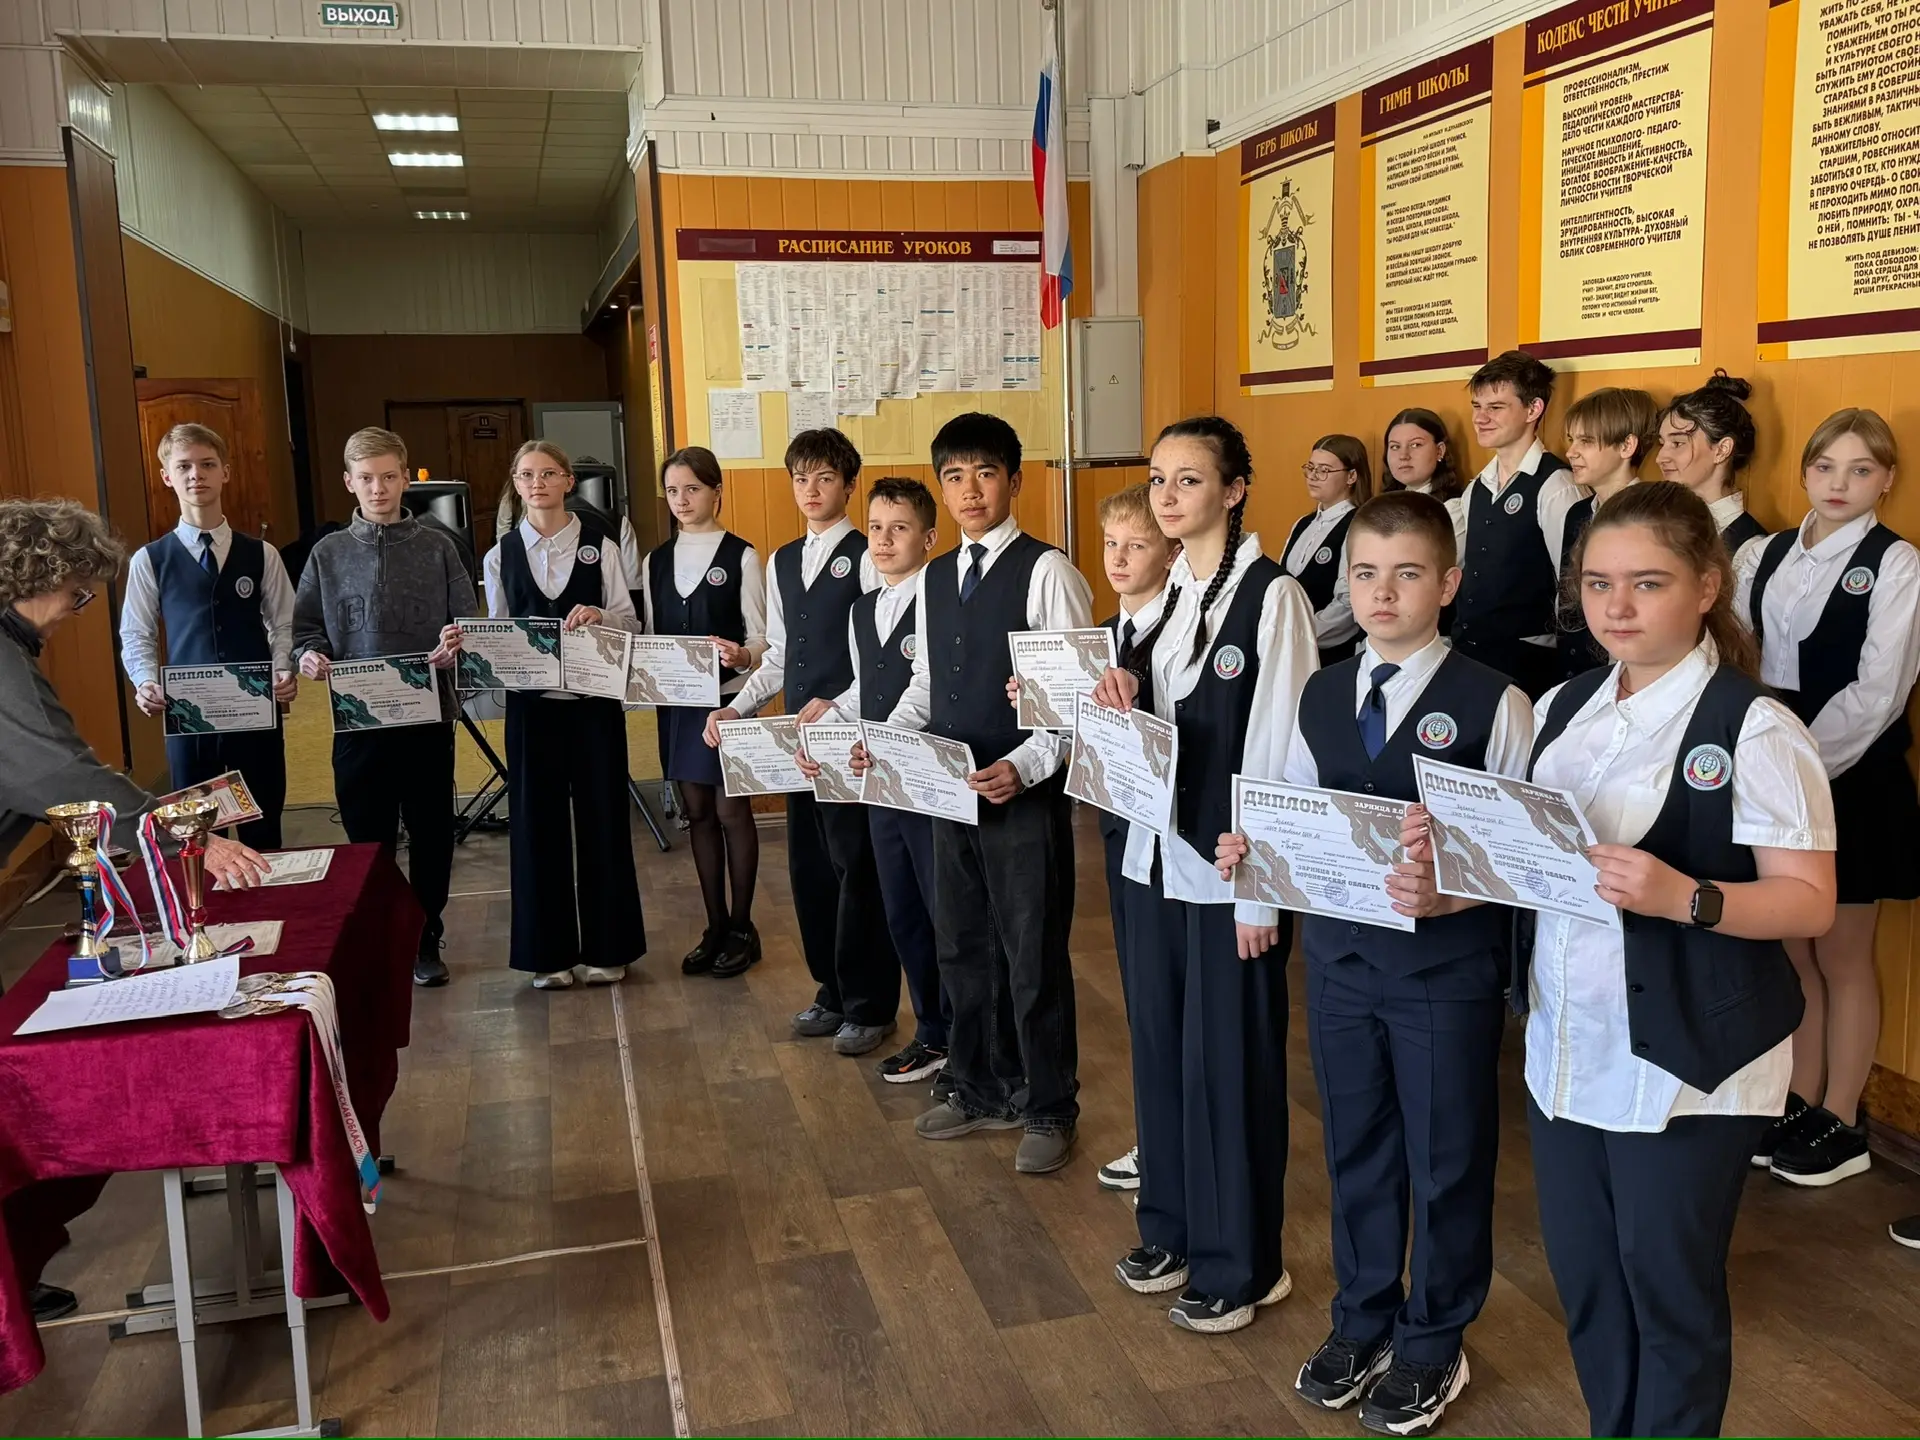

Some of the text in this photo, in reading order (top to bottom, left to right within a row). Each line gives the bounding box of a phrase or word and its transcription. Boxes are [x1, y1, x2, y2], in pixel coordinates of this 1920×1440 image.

[327, 8, 390, 24] ВЫХОД
[1818, 10, 1859, 31] УВАЖАТЬ
[1860, 2, 1884, 17] СЕБЯ,
[1820, 2, 1844, 17] ЖИТЬ
[1537, 16, 1585, 54] КОДЕКС
[1589, 1, 1629, 33] ЧЕСТИ
[1826, 20, 1872, 42] ПОМНИТЬ,
[1874, 12, 1892, 25] ЧТО
[1894, 6, 1907, 20] ТЫ
[1825, 33, 1913, 67] И КУЛЬТУРЕ СВОЕГО
[1826, 44, 1831, 54] С
[1833, 26, 1888, 52] УВАЖЕНИЕМ
[1815, 44, 1920, 82] БЫТЬ ПАТРИОТОМ СВОЕ
[1379, 63, 1469, 114] ГИМН ШКОЛЫ
[1563, 61, 1642, 94] ПРОФЕССИОНАЛИЗМ,
[1563, 62, 1669, 103] ОТВЕТСТВЕННОСТЬ, ПРЕСТИЖ
[1814, 75, 1855, 94] СЛУЖИТЬ
[1856, 68, 1875, 82] ЕМУ
[1823, 83, 1868, 104] СТАРАТЬСЯ
[1870, 81, 1876, 92] В
[1562, 92, 1633, 121] ВЫСОКИЙ УРОВЕНЬ
[1562, 103, 1630, 131] ПЕДАГОГИЧЕСКОГО
[1812, 96, 1920, 133] БЫТЬ ВЕЖЛИВЫМ, ТАКТИЧ
[1822, 97, 1867, 117] ЗНАНИЯМИ
[1868, 95, 1874, 105] В
[1561, 99, 1681, 142] ДЕЛО ЧЕСТИ КАЖДОГО УЧИТЕЛЯ
[1256, 120, 1318, 159] ГЕРБ ШКОЛЫ
[1811, 121, 1881, 147] ДАННОМУ СЛОВУ.
[1819, 125, 1920, 156] УВАЖИТЕЛЬНО ОТНОСИТ
[1561, 141, 1594, 157] НАУЧНОЕ
[1561, 139, 1643, 167] ГИЧЕСКОЕ МЫШЛЕНИЕ,
[1561, 139, 1687, 177] ИНИЦИАТИВНОСТЬ И АКТИВНОСТЬ,
[1862, 139, 1920, 160] РОВЕСНИКАМ
[1560, 163, 1673, 197] И СПОСОБНОСТИ ТВОРЧЕСКОЙ
[1561, 172, 1590, 187] БОГАТОЕ
[1809, 188, 1815, 198] В
[1816, 182, 1848, 197] ПЕРВУЮ
[1891, 171, 1898, 182] О
[1899, 167, 1920, 181] СВО
[1810, 167, 1854, 185] ЗАБОТИТЬСЯ
[1855, 165, 1862, 175] О
[1863, 162, 1879, 174] ТЕХ,
[1880, 158, 1896, 170] КТО
[1560, 183, 1632, 207] ЛИЧНОСТИ УЧИТЕЛЯ
[1809, 182, 1920, 211] НЕ ПРОХОДИТЬ МИМО ПОП
[1560, 205, 1635, 227] ИНТЕЛЛИГЕНТНОСТЬ,
[1817, 196, 1919, 222] ЛЮБИТЬ ПРИРОДУ, ОХРА
[1559, 232, 1602, 248] ВНУТРЕННЯЯ
[1643, 217, 1688, 234] ДУХОВНЫЙ
[1560, 208, 1674, 238] ЭРУДИРОВАННОСТЬ, ВЫСОКАЯ
[1808, 222, 1920, 249] НЕ ПОЗВОЛЯТЬ ДУШЕ ЛЕНИТ
[1816, 225, 1823, 235] О
[1846, 215, 1890, 230] ПОМНИТЬ:
[1893, 211, 1906, 222] ТЫ
[778, 240, 972, 254] РАСПИСАНИЕ УРОКОВ
[1559, 229, 1681, 259] ОБЛИК СОВРЕМЕННОГО УЧИТЕЛЯ
[1845, 245, 1919, 262] ЖИТЬ ПОД ДЕВИЗОМ:
[1853, 262, 1918, 277] ПОКА СЕРДЦА ДЛЯ
[1854, 254, 1917, 269] ПОКА СВОБОДОЮ
[1853, 276, 1870, 286] МОЙ
[1870, 275, 1890, 284] ДРУГ,
[1853, 285, 1875, 295] ДУШИ
[462, 625, 514, 633] ДИПЛОМ
[1017, 640, 1064, 653] ДИПЛОМ
[169, 670, 224, 681] ДИПЛОМ
[332, 664, 385, 677] ДИПЛОМ
[1081, 702, 1130, 730] ДИПЛОМ
[721, 726, 762, 738] ДИПЛОМ
[809, 731, 857, 742] ДИПЛОМ
[868, 728, 920, 746] ДИПЛОМ
[1425, 772, 1501, 801] ДИПЛОМ
[1244, 790, 1328, 816] ДИПЛОМ
[1348, 881, 1380, 891] ОБЛАСТЬ
[346, 1118, 364, 1154] ОБЛАСТЬ
